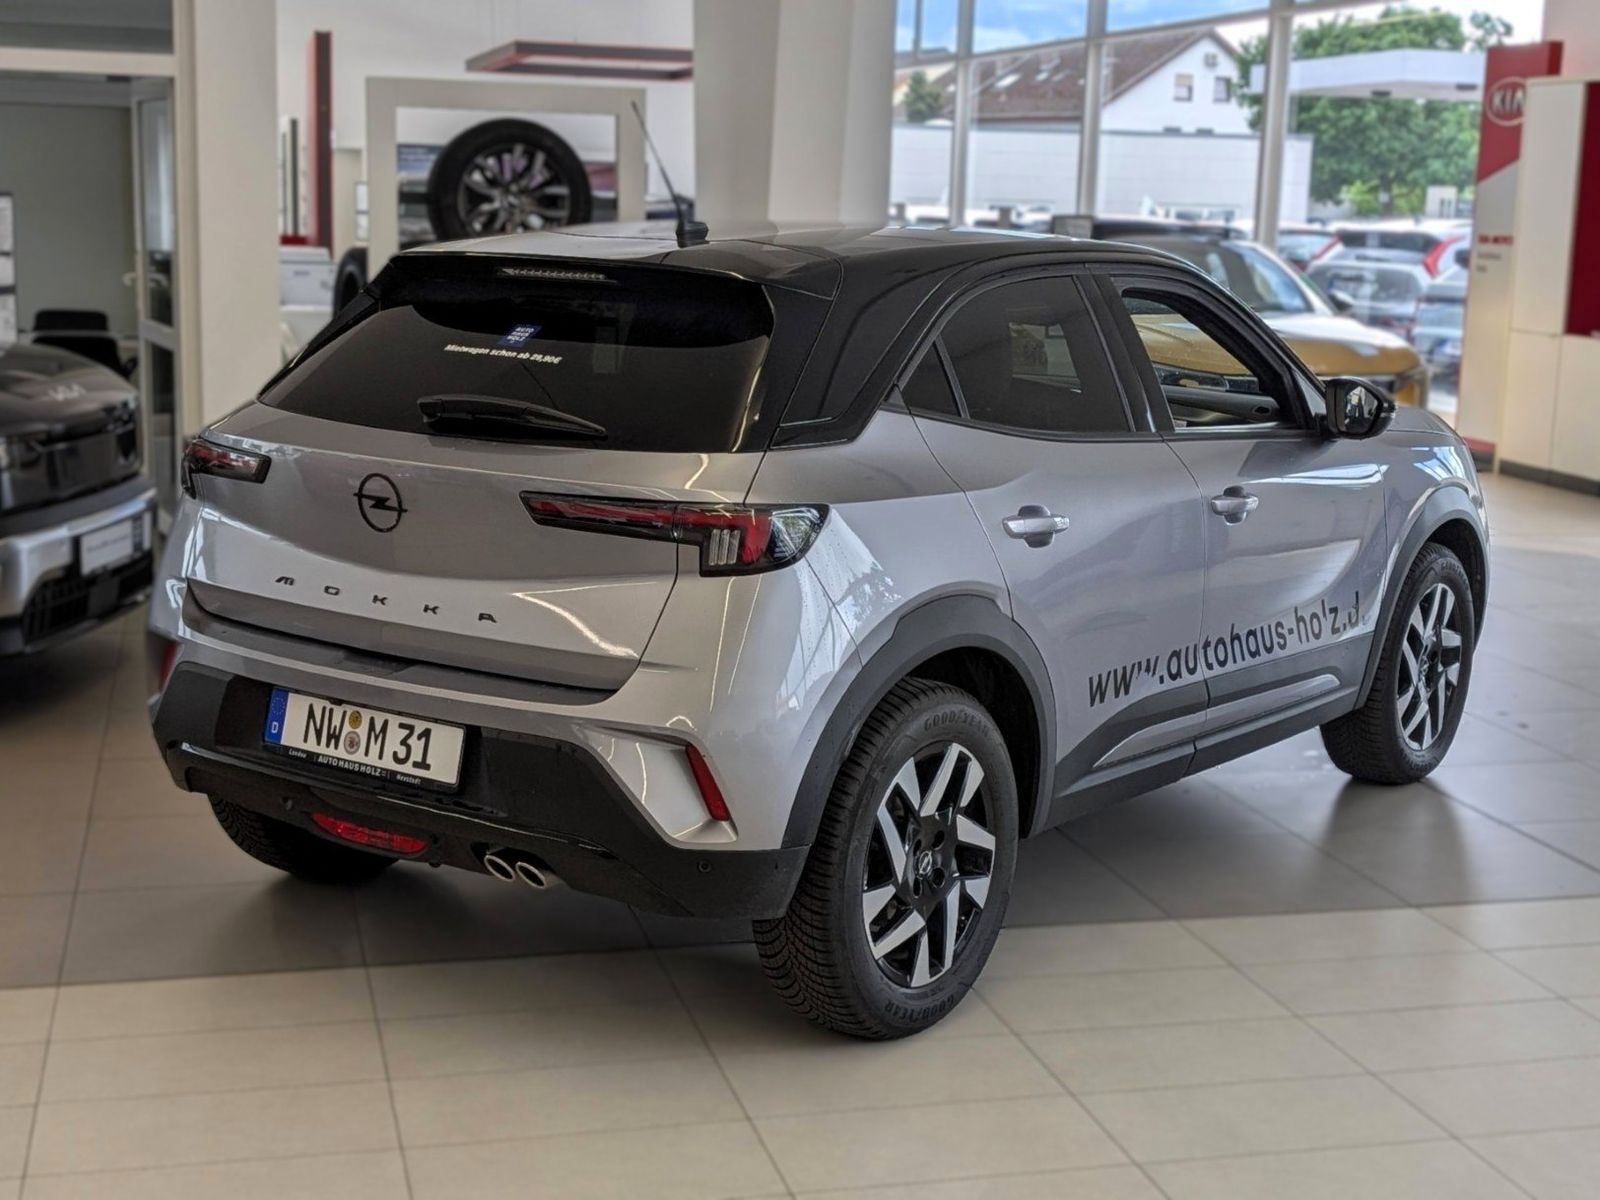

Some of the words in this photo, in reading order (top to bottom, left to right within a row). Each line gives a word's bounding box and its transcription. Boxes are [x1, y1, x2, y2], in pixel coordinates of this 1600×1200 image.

[275, 576, 497, 623] MOKKA
[271, 721, 279, 734] D
[303, 703, 347, 751] NW
[364, 716, 389, 761] M
[392, 722, 432, 771] 31
[360, 765, 382, 776] HOLZ
